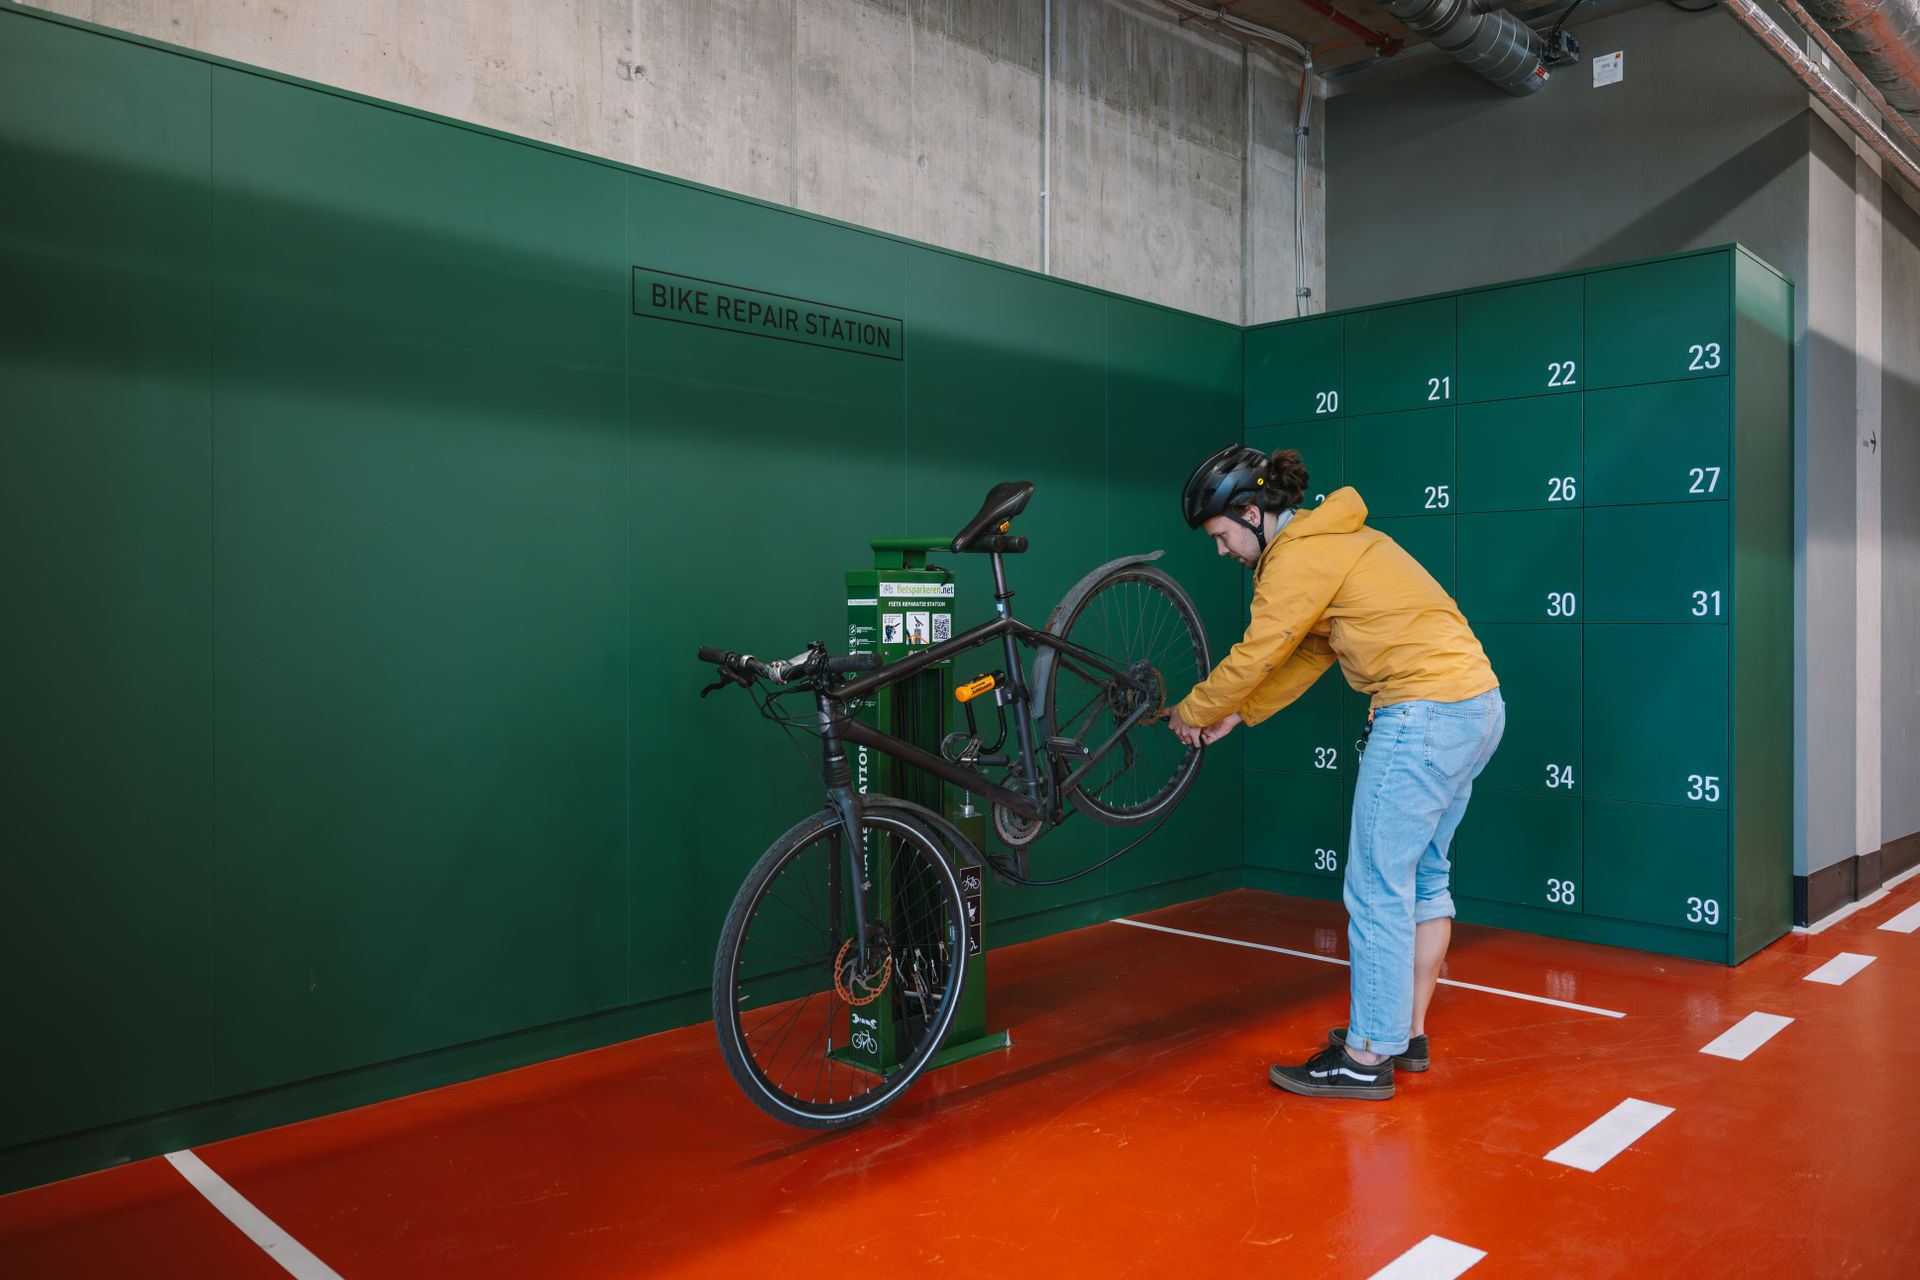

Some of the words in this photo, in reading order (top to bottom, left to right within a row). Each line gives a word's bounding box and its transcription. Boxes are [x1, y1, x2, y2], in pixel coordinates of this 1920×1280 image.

[652, 283, 709, 316] BIKE
[717, 295, 799, 333] REPAIR
[805, 313, 890, 349] STATION
[1688, 342, 1721, 371] 23
[1547, 360, 1576, 387] 22
[1315, 390, 1338, 414] 20
[1427, 376, 1450, 401] 21
[1548, 476, 1576, 502] 26
[1689, 466, 1721, 494] 27
[1424, 485, 1450, 509] 25
[897, 585, 954, 595] fietsparkeren.net
[1691, 590, 1720, 617] 31
[1546, 592, 1576, 617] 30
[1314, 746, 1337, 770] 32
[1545, 763, 1575, 790] 34
[1687, 774, 1720, 802] 35
[1314, 848, 1337, 872] 36
[1546, 878, 1575, 905] 38
[1686, 896, 1719, 925] 39
